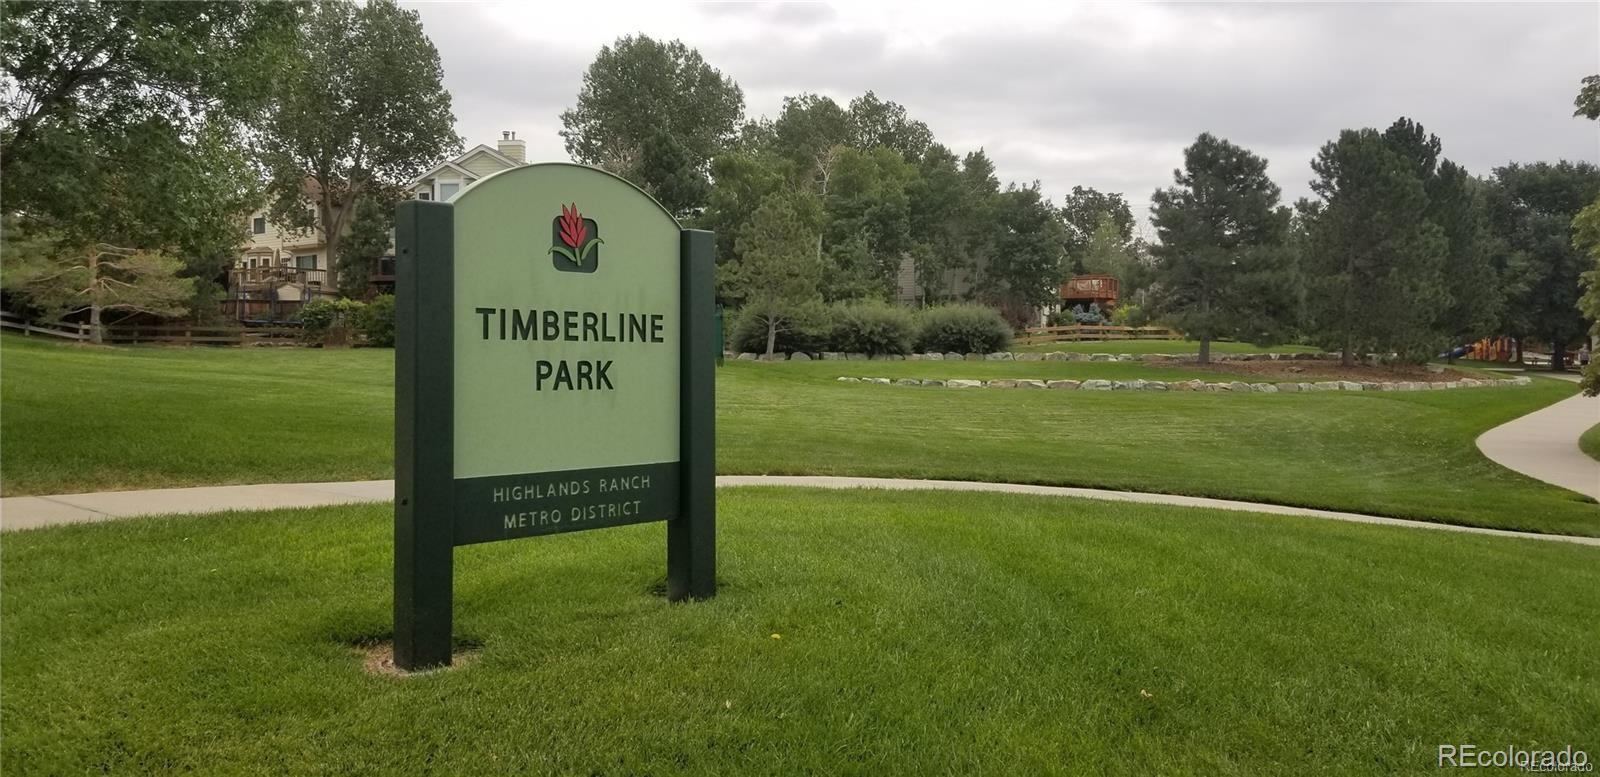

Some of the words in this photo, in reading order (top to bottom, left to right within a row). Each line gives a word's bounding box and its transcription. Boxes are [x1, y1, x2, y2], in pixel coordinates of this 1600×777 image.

[475, 307, 665, 343] TIMBERLINE
[535, 360, 614, 391] PARK
[493, 480, 590, 503] HIGHLANDS
[599, 475, 651, 493] RANCH
[503, 509, 562, 529] METRO
[571, 500, 642, 521] DISTRICT
